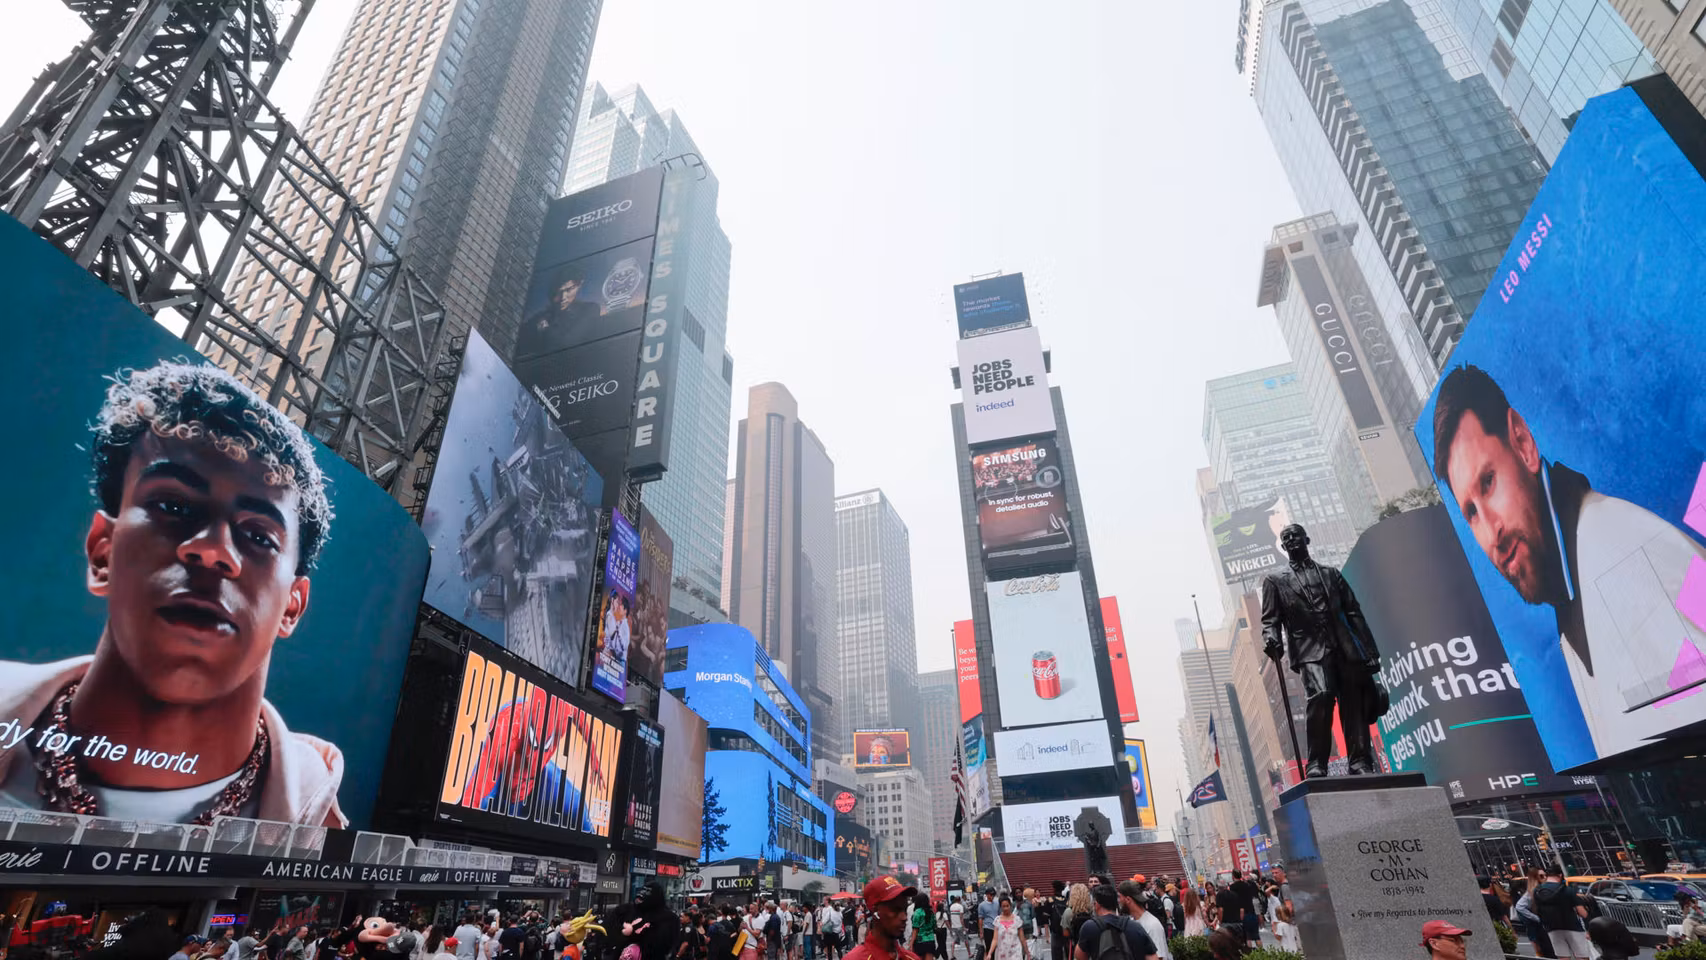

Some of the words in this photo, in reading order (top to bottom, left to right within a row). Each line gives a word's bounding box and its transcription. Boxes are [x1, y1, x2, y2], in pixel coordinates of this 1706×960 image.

[566, 199, 632, 229] SEIKO
[656, 180, 683, 279] TIMES
[1500, 270, 1519, 304] LEO
[1518, 212, 1552, 272] MESSI
[1315, 303, 1357, 374] GUCCI
[634, 295, 668, 448] SQUARE
[972, 358, 1012, 375] JOBS
[577, 372, 604, 384] Classic
[972, 369, 1013, 385] NEED
[974, 375, 1035, 395] PEOPLE
[567, 379, 619, 404] SEIKO
[976, 398, 1015, 413] indeed
[983, 448, 1047, 467] SAMSUNG
[995, 503, 1027, 513] detailed
[1027, 500, 1049, 509] audio
[996, 496, 1014, 506] sync
[1015, 494, 1027, 502] for
[1027, 491, 1054, 500] robust,
[612, 542, 635, 571] MAYBE
[610, 552, 635, 579] HAPPY
[609, 561, 633, 590] ENDING
[696, 672, 732, 683] Morgan
[960, 665, 976, 674] your
[1381, 679, 1430, 734] network
[1431, 662, 1521, 702] that
[36, 725, 82, 753] for
[83, 736, 129, 762] the
[133, 746, 199, 775] world.
[441, 650, 547, 820] BRAND
[533, 694, 592, 831] NEW
[581, 717, 622, 837] DAY
[1038, 744, 1068, 754] indeed
[1391, 734, 1416, 770] gets
[1413, 718, 1446, 757] you
[1488, 773, 1539, 790] HPE
[1573, 778, 1595, 786] NYSE
[1048, 815, 1071, 824] JOBS
[1049, 822, 1071, 831] NEED
[1357, 838, 1423, 854] GEORGE
[92, 851, 211, 873] OFFLINE
[634, 857, 647, 868] BLUE
[1388, 854, 1404, 867] M
[263, 861, 354, 880] AMERICAN
[361, 868, 403, 882] EAGLE
[419, 869, 439, 883] aerie
[454, 871, 498, 884] OFFLINE
[933, 859, 946, 887] tkts
[1370, 867, 1429, 881] COHAN
[716, 878, 753, 889] KLIKTIX
[1381, 886, 1425, 897] 1878-1942
[1357, 909, 1372, 920] Give
[1374, 911, 1385, 919] my
[1386, 908, 1416, 919] Regards
[1418, 908, 1425, 916] to
[1427, 907, 1464, 917] Broadway
